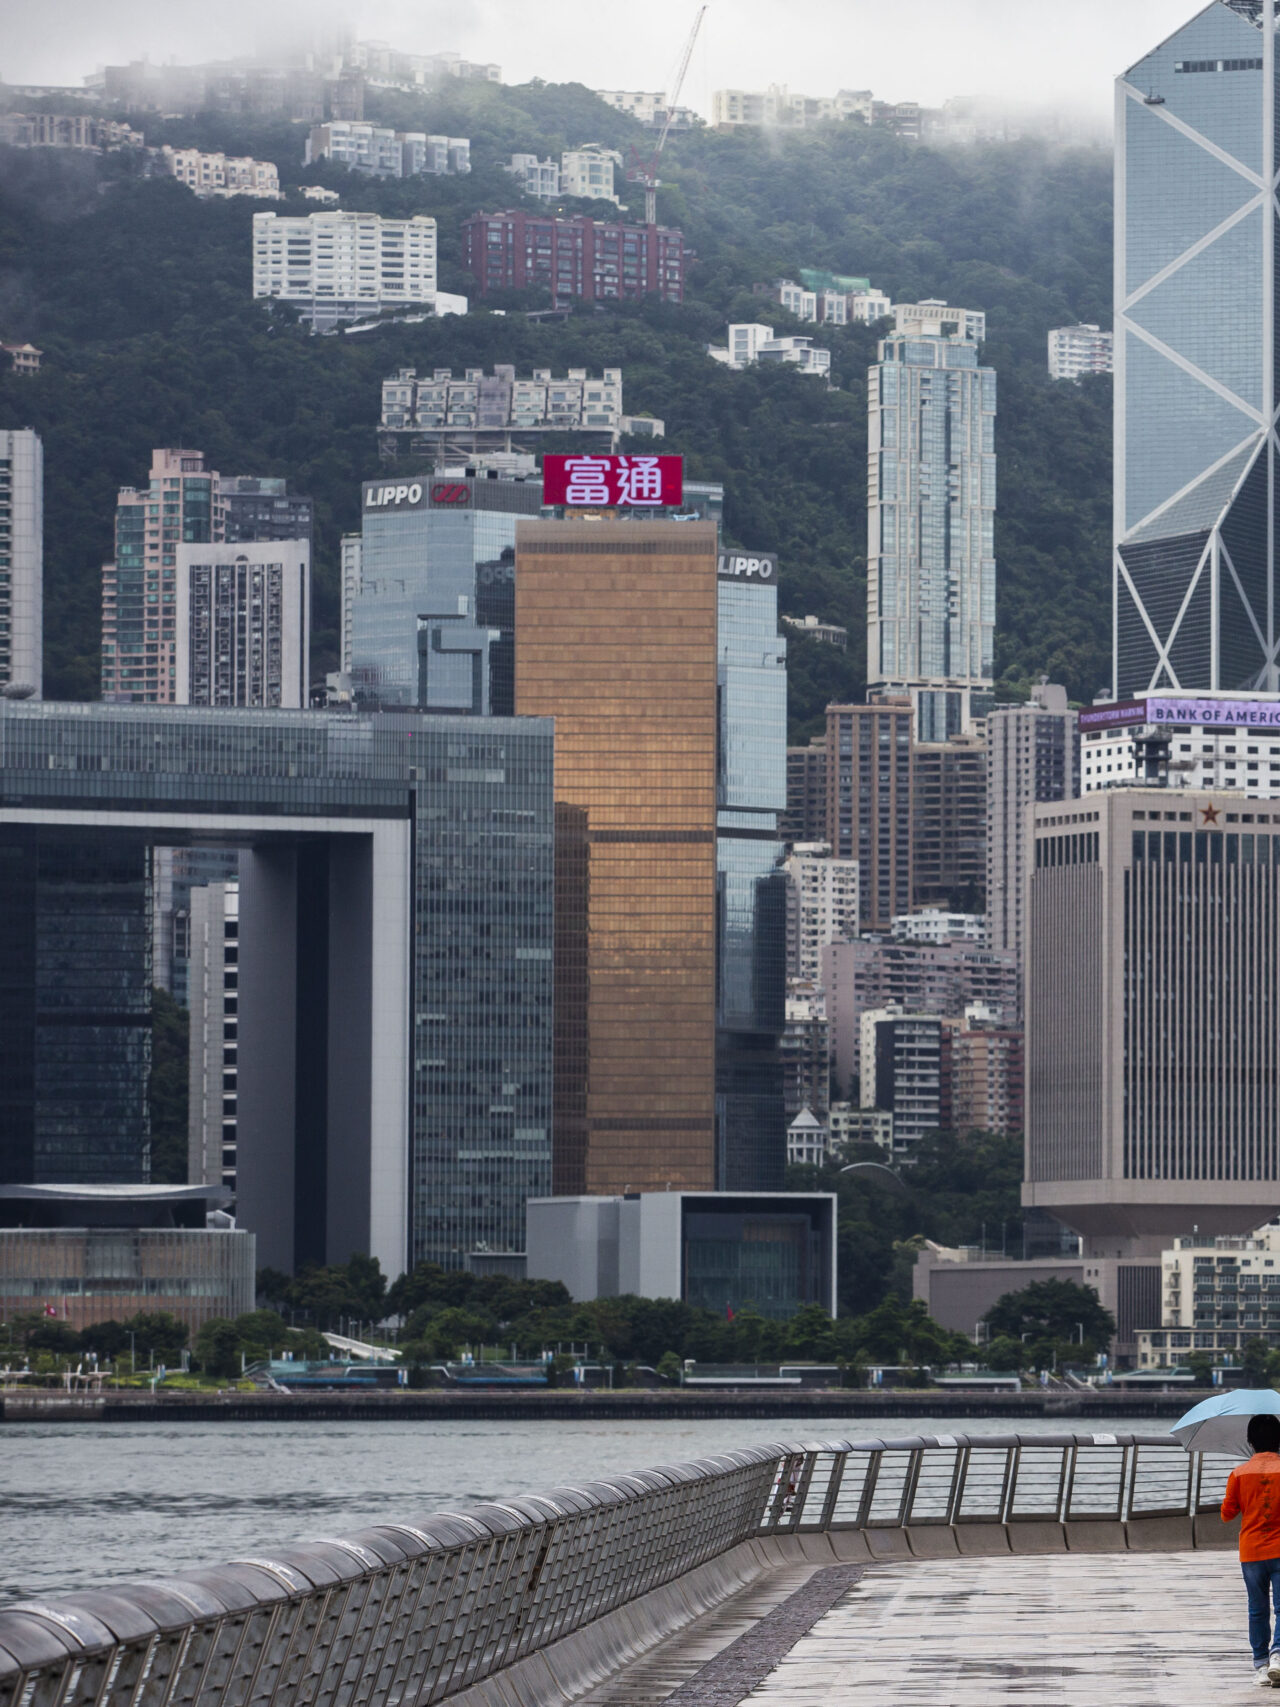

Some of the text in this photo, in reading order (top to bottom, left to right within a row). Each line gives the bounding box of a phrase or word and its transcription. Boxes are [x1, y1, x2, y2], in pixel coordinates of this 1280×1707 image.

[564, 456, 663, 505] 富通
[366, 483, 422, 506] LIPPO
[717, 555, 772, 578] LIPPO
[1156, 708, 1198, 720] BANK
[1202, 710, 1221, 721] OF
